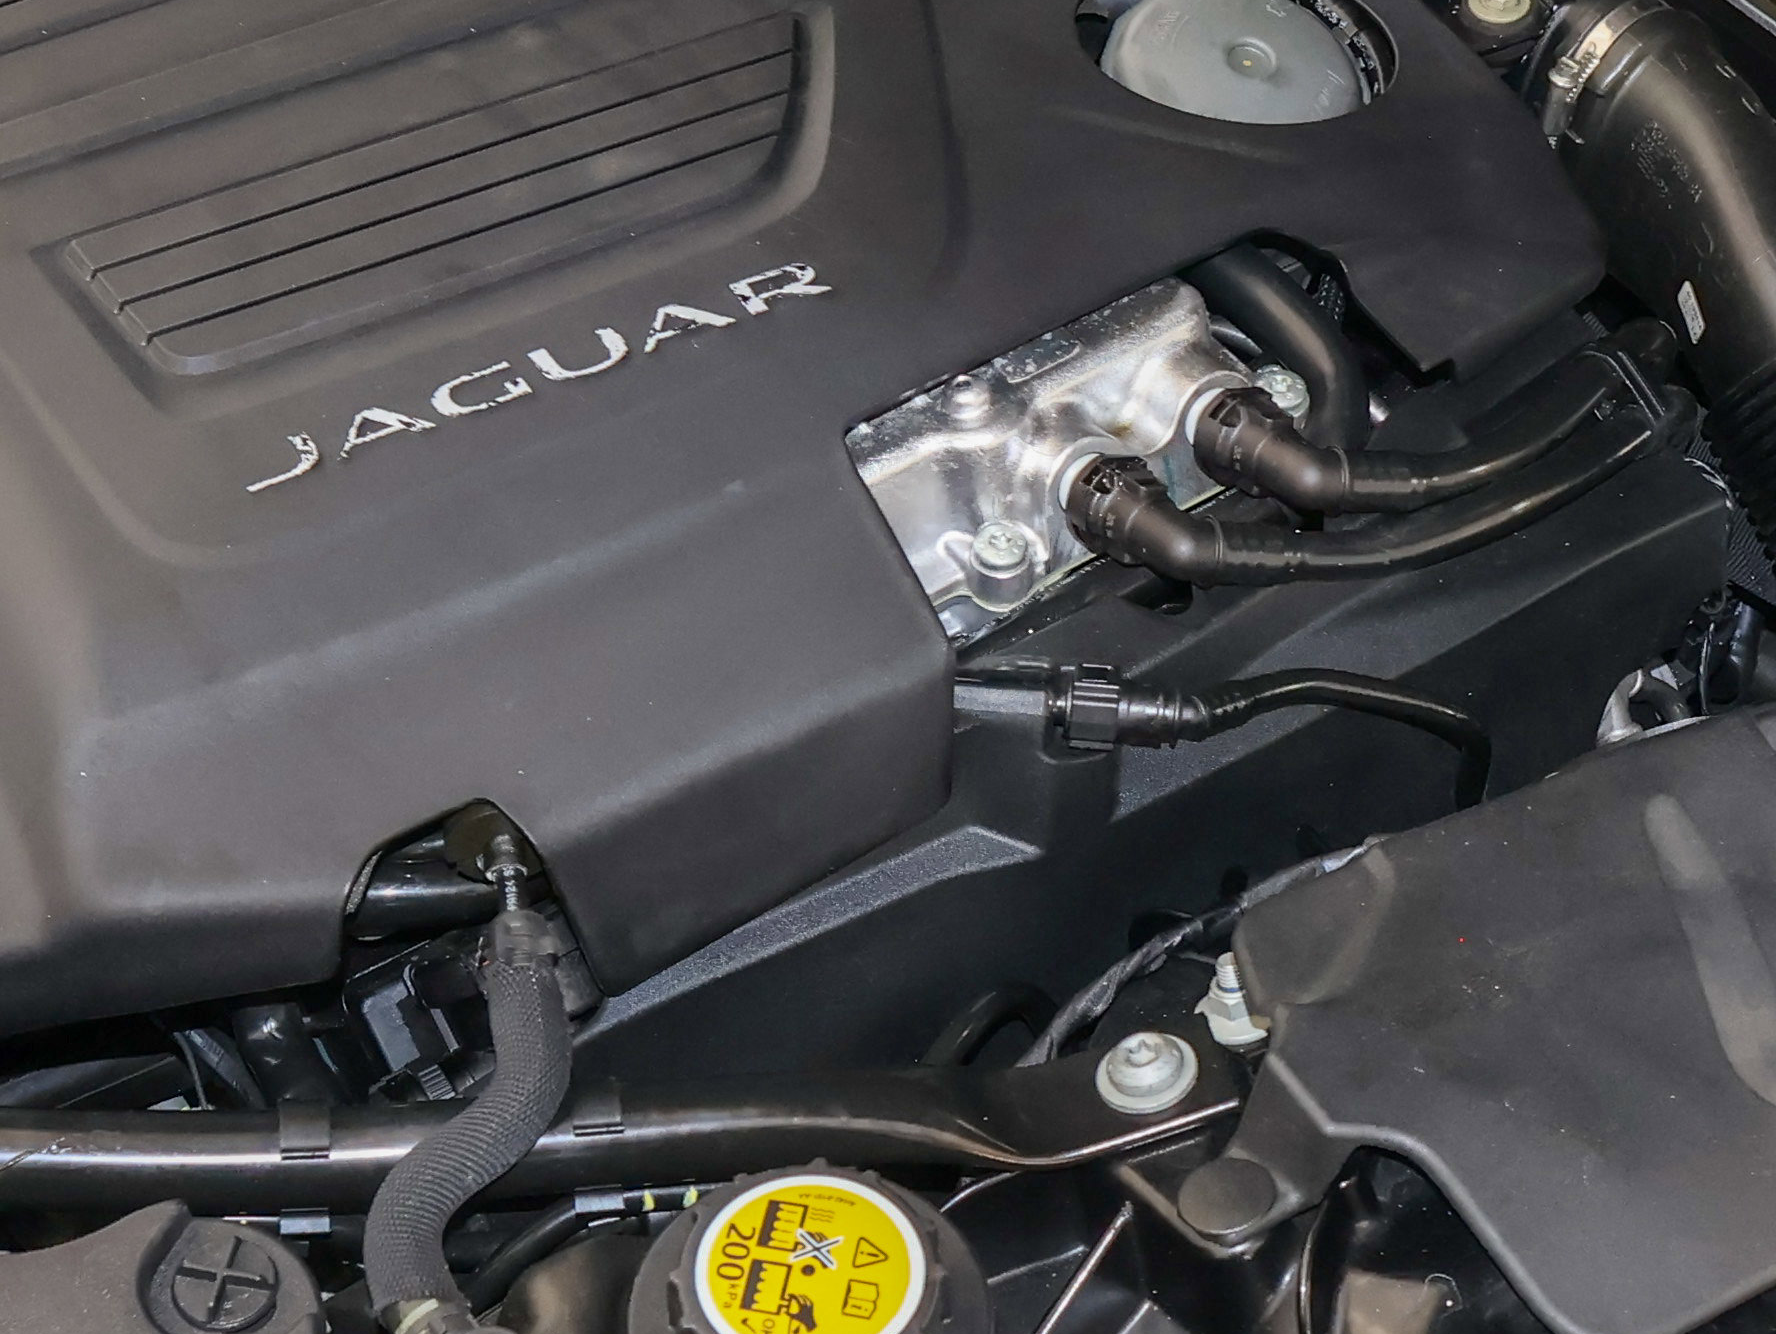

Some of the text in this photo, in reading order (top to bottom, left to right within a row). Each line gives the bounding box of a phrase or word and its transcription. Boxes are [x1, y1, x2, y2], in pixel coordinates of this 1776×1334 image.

[245, 261, 833, 494] JAGUAR
[717, 1223, 756, 1309] 200 kPa
